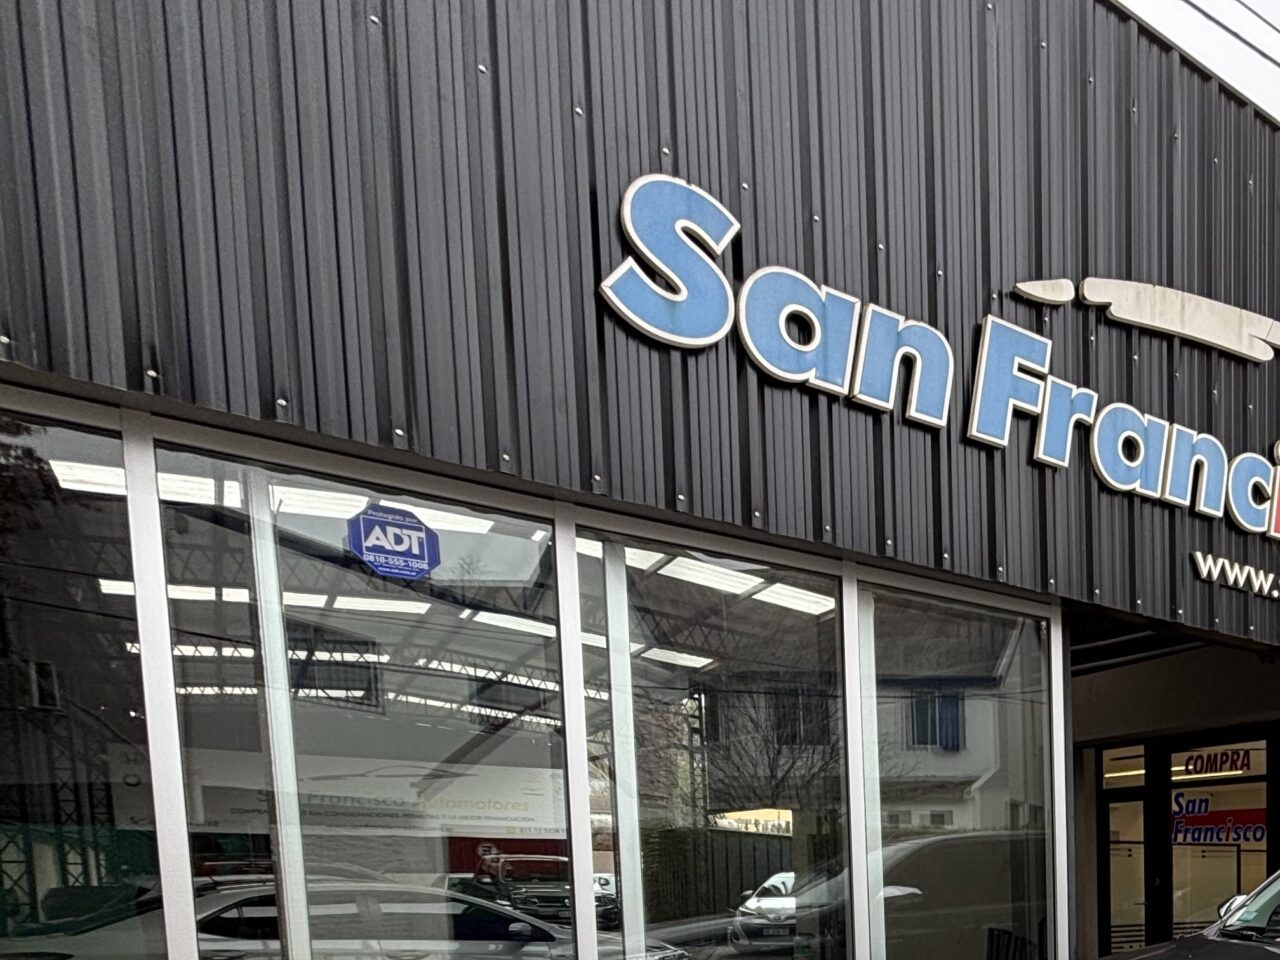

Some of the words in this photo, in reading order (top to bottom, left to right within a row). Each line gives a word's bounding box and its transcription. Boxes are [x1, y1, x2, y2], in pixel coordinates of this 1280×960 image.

[600, 173, 954, 428] San
[364, 524, 424, 556] ADT
[1185, 750, 1251, 775] COMPRA
[1172, 791, 1210, 817] San
[1171, 816, 1267, 843] Francisco
